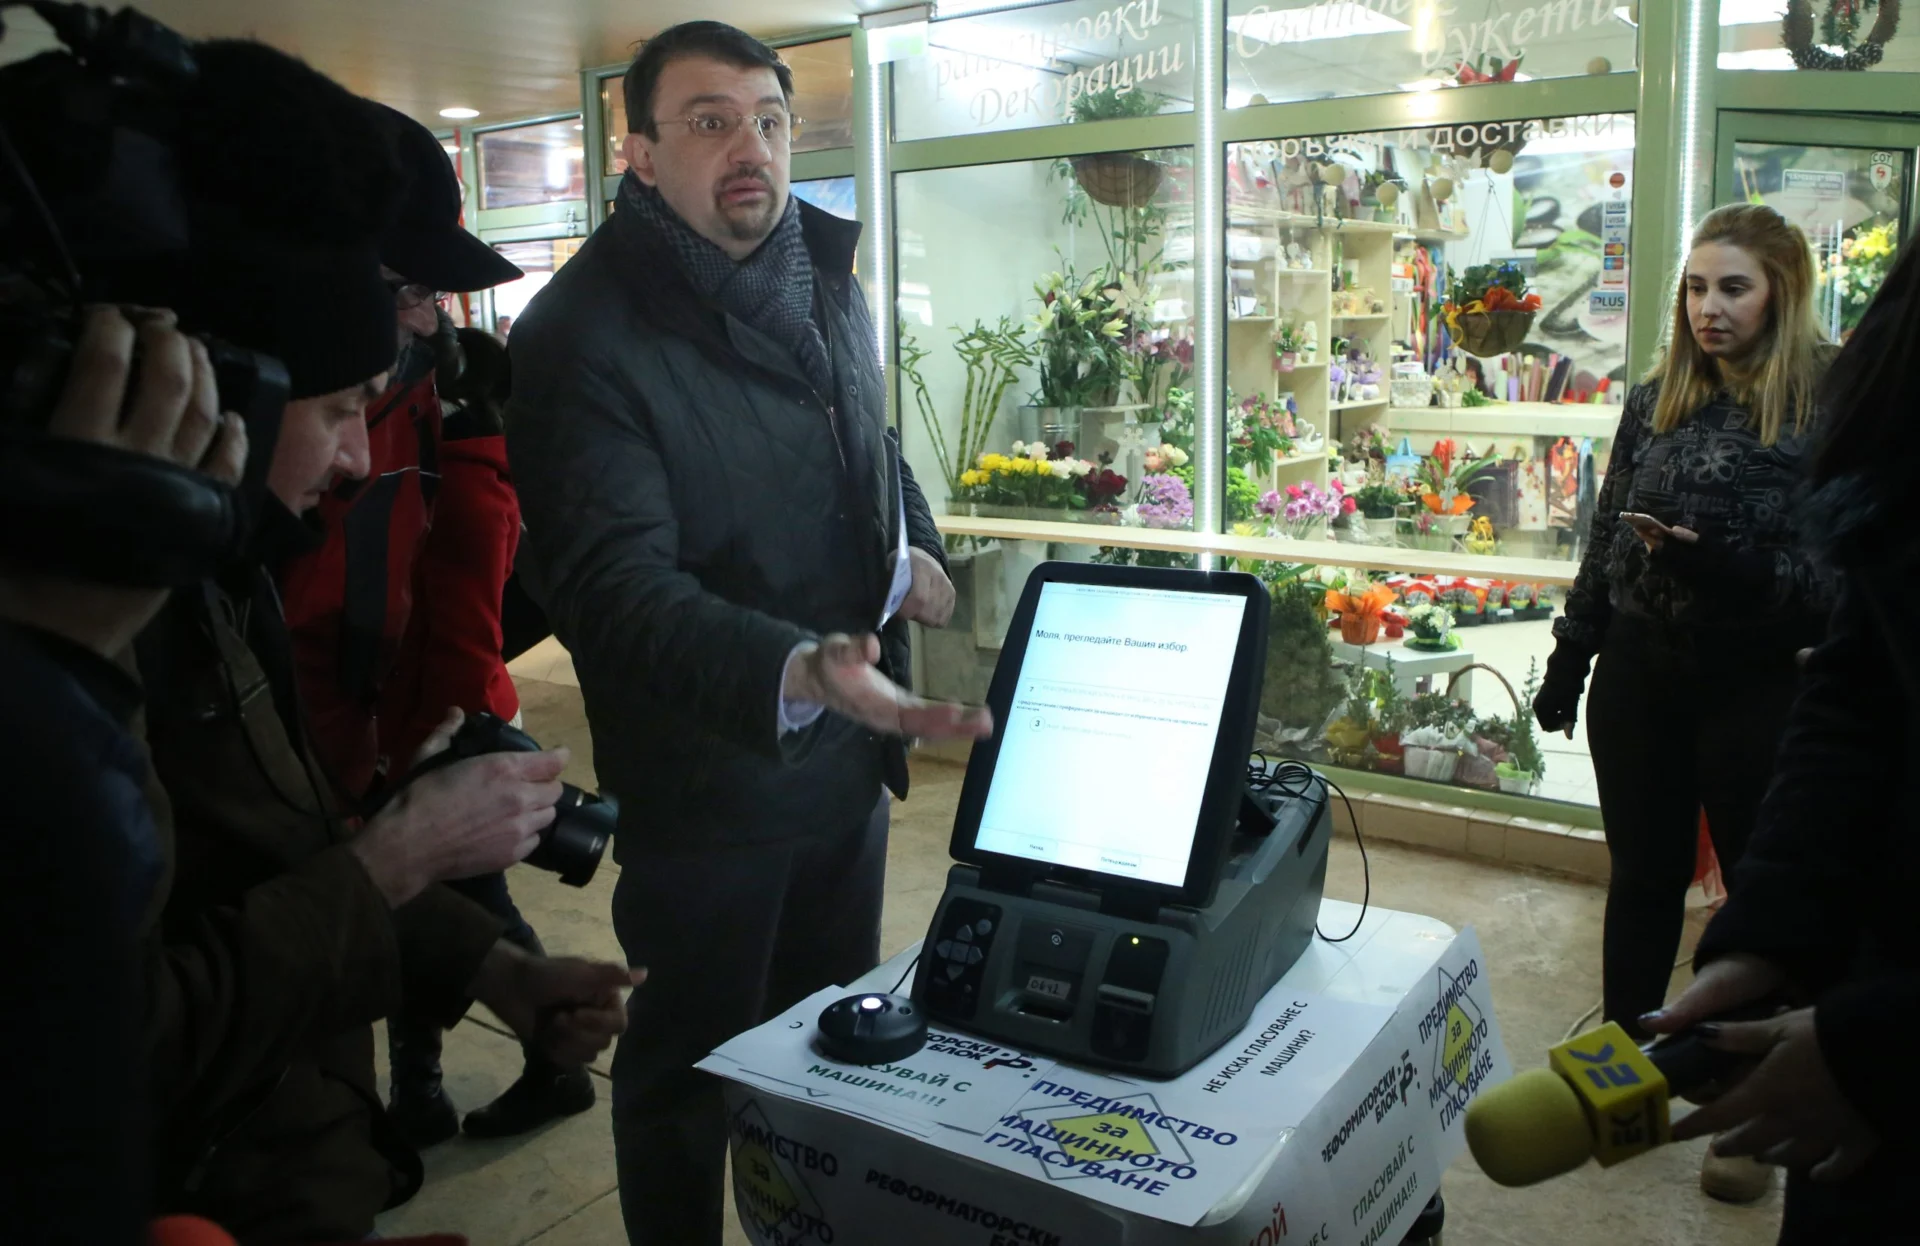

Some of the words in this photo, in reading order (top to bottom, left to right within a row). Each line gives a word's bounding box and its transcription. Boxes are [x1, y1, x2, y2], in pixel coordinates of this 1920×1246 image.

[969, 43, 1184, 127] Декорации
[1430, 114, 1616, 154] доставки
[1035, 629, 1061, 641] Моля,
[1063, 632, 1122, 647] прегледайте
[1124, 637, 1156, 650] Вашия
[1418, 958, 1478, 1044] ПРЕДИМСТВО
[926, 1043, 989, 1061] БЛОК
[1202, 1079, 1227, 1094] НЕ
[1217, 1056, 1254, 1079] ИСКА
[1244, 1008, 1302, 1056] ГЛАСУВАНЕ
[1260, 1029, 1316, 1076] МАШИНИ?
[1451, 1020, 1461, 1043] за
[807, 1065, 947, 1107] МАШИНА!!!
[953, 1081, 972, 1092] С
[1428, 1018, 1488, 1109] МАШИННОТО
[1440, 1048, 1494, 1132] ГЛАСУВАНЕ
[1031, 1079, 1238, 1147] ПРЕДИМСТВО
[1092, 1121, 1129, 1139] за
[1375, 1085, 1399, 1124] БЛОК
[983, 1132, 1170, 1197] ГЛАСУВАНЕ
[1352, 1142, 1407, 1226] ГЛАСУВАЙ
[1407, 1135, 1415, 1154] С
[864, 1167, 1063, 1246] РЕФОРМАТОРСКИ
